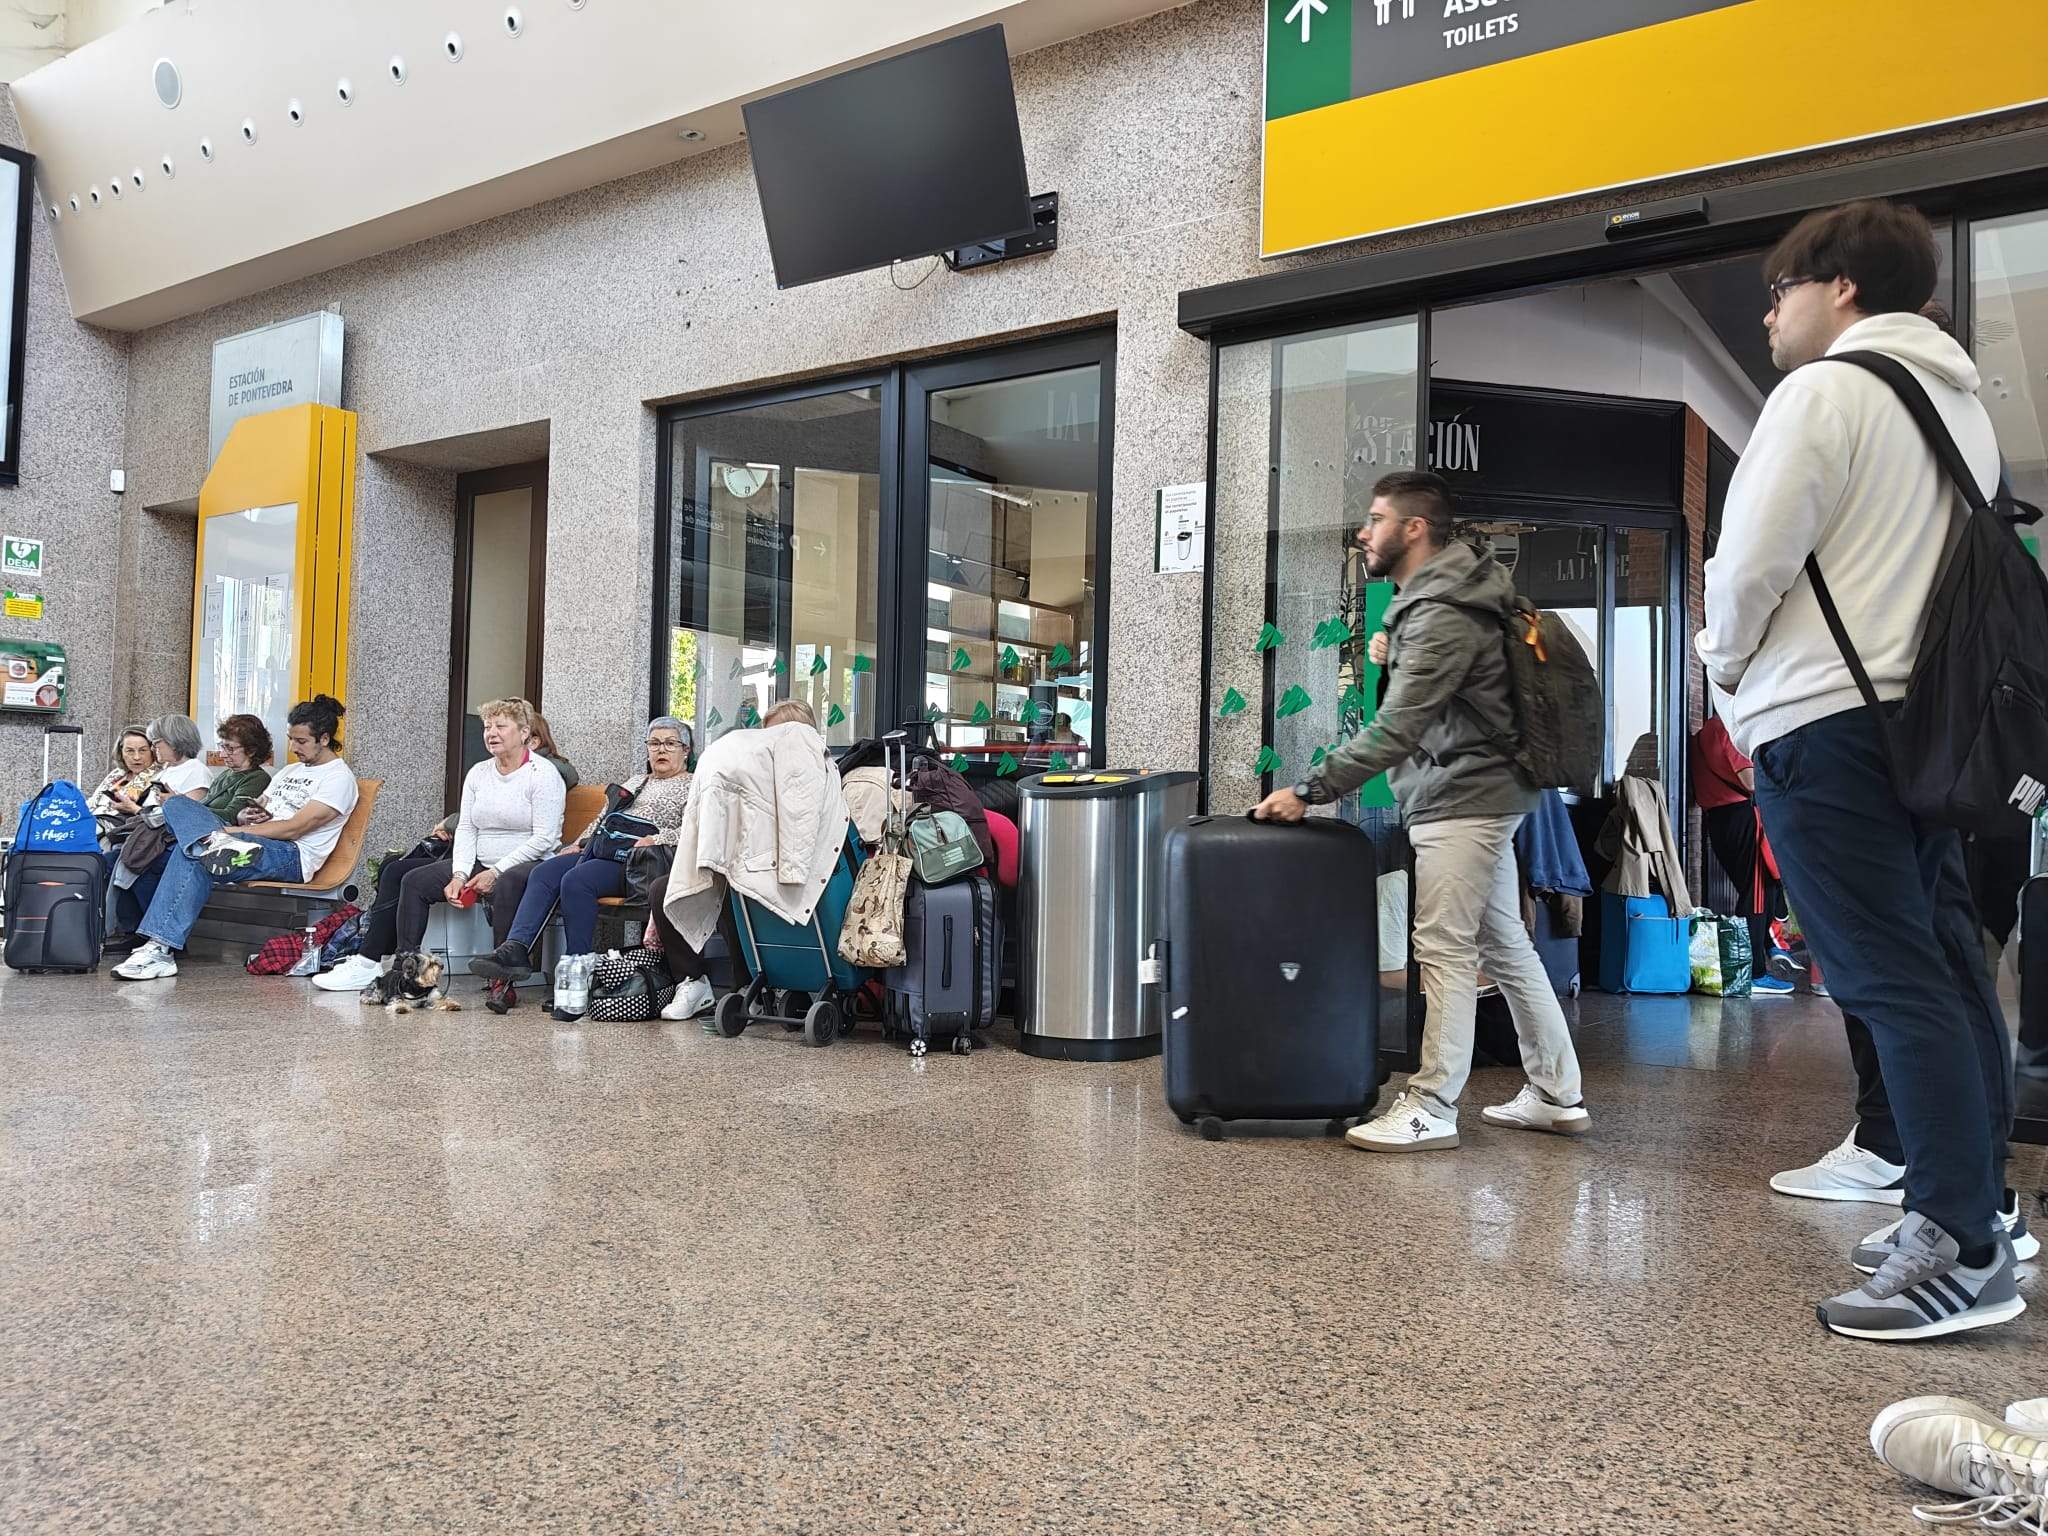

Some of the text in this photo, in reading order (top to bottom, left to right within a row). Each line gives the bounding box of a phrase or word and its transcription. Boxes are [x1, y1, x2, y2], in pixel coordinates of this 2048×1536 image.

[1442, 13, 1519, 48] TOILETS
[229, 366, 265, 389] ESTACIÓN
[228, 379, 293, 407] DE PONTEVEDRA
[7, 557, 36, 569] DESA
[42, 829, 69, 842] Hugo
